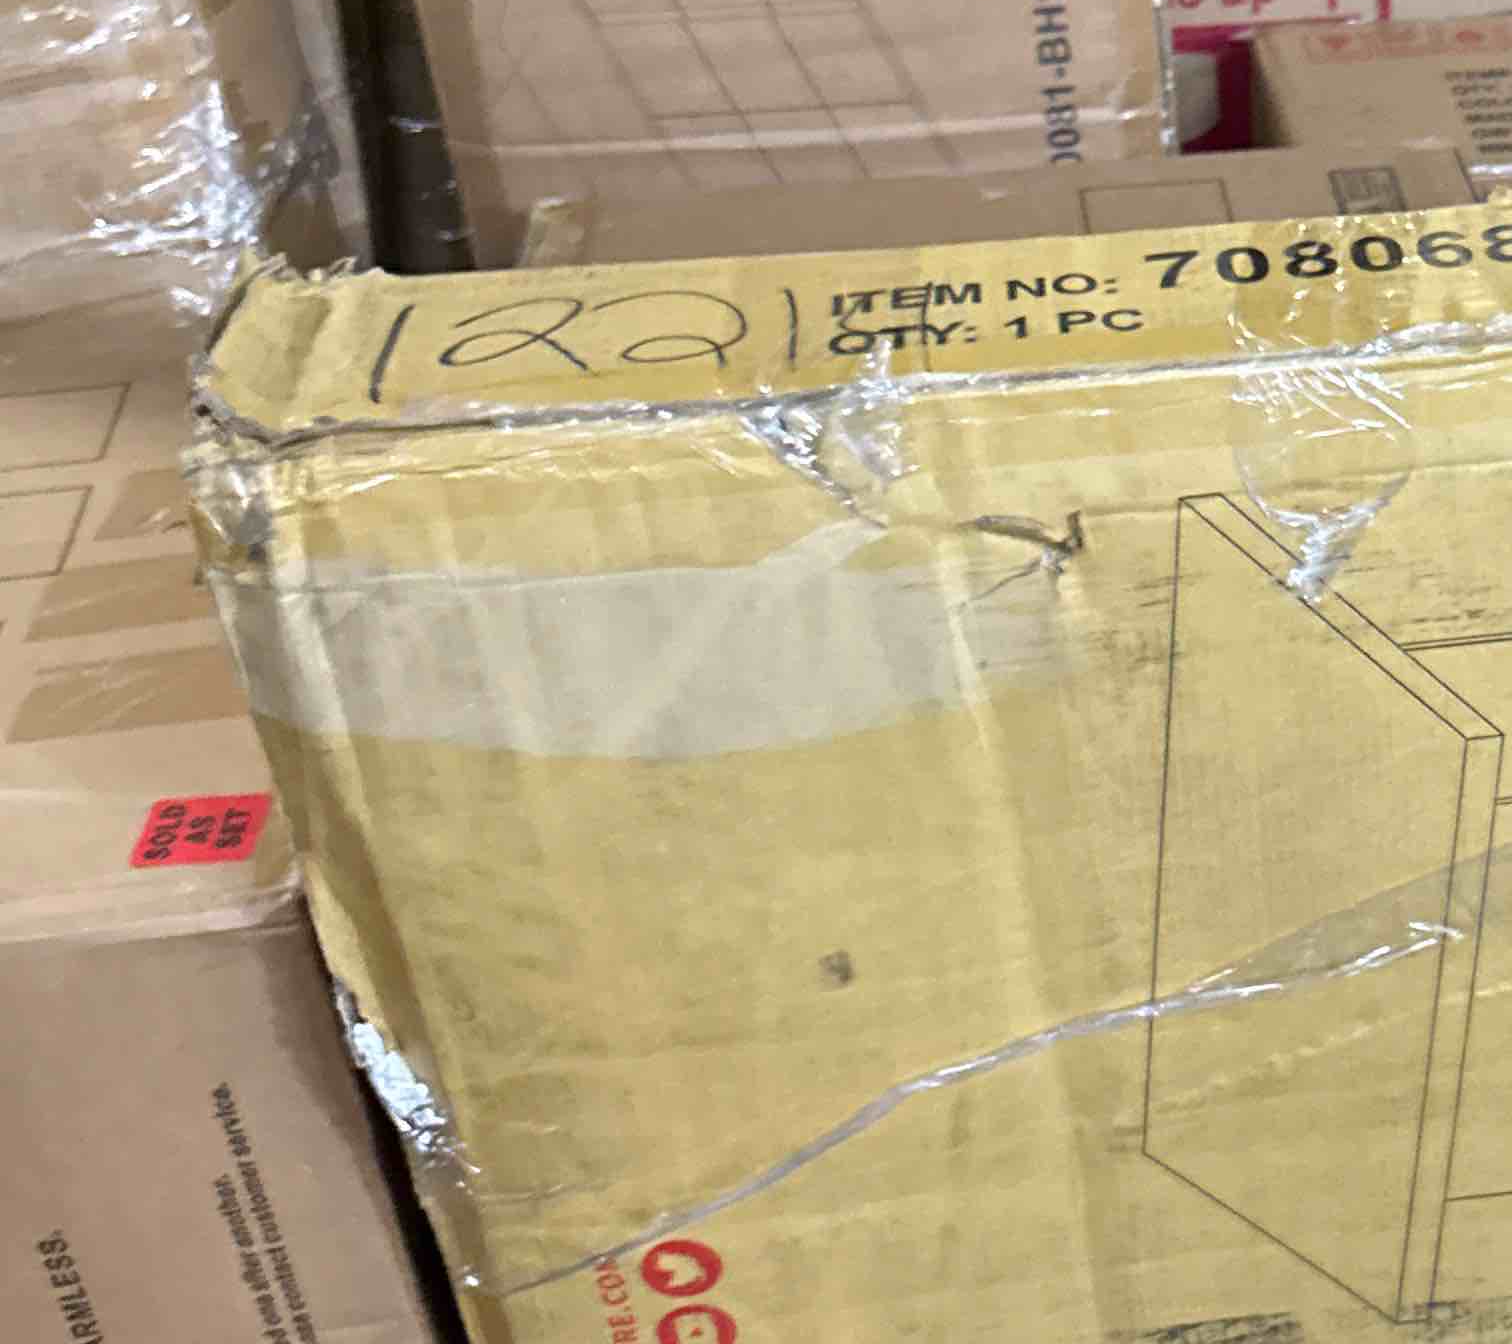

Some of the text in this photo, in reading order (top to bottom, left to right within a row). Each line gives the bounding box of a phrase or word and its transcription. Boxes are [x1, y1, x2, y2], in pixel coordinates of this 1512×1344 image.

[831, 282, 983, 317] ITEM
[1006, 272, 1117, 301] NO:
[829, 308, 1144, 356] QTY: 1 PC
[143, 803, 187, 861] SOLD
[184, 814, 216, 845] AS
[214, 807, 252, 849] SET
